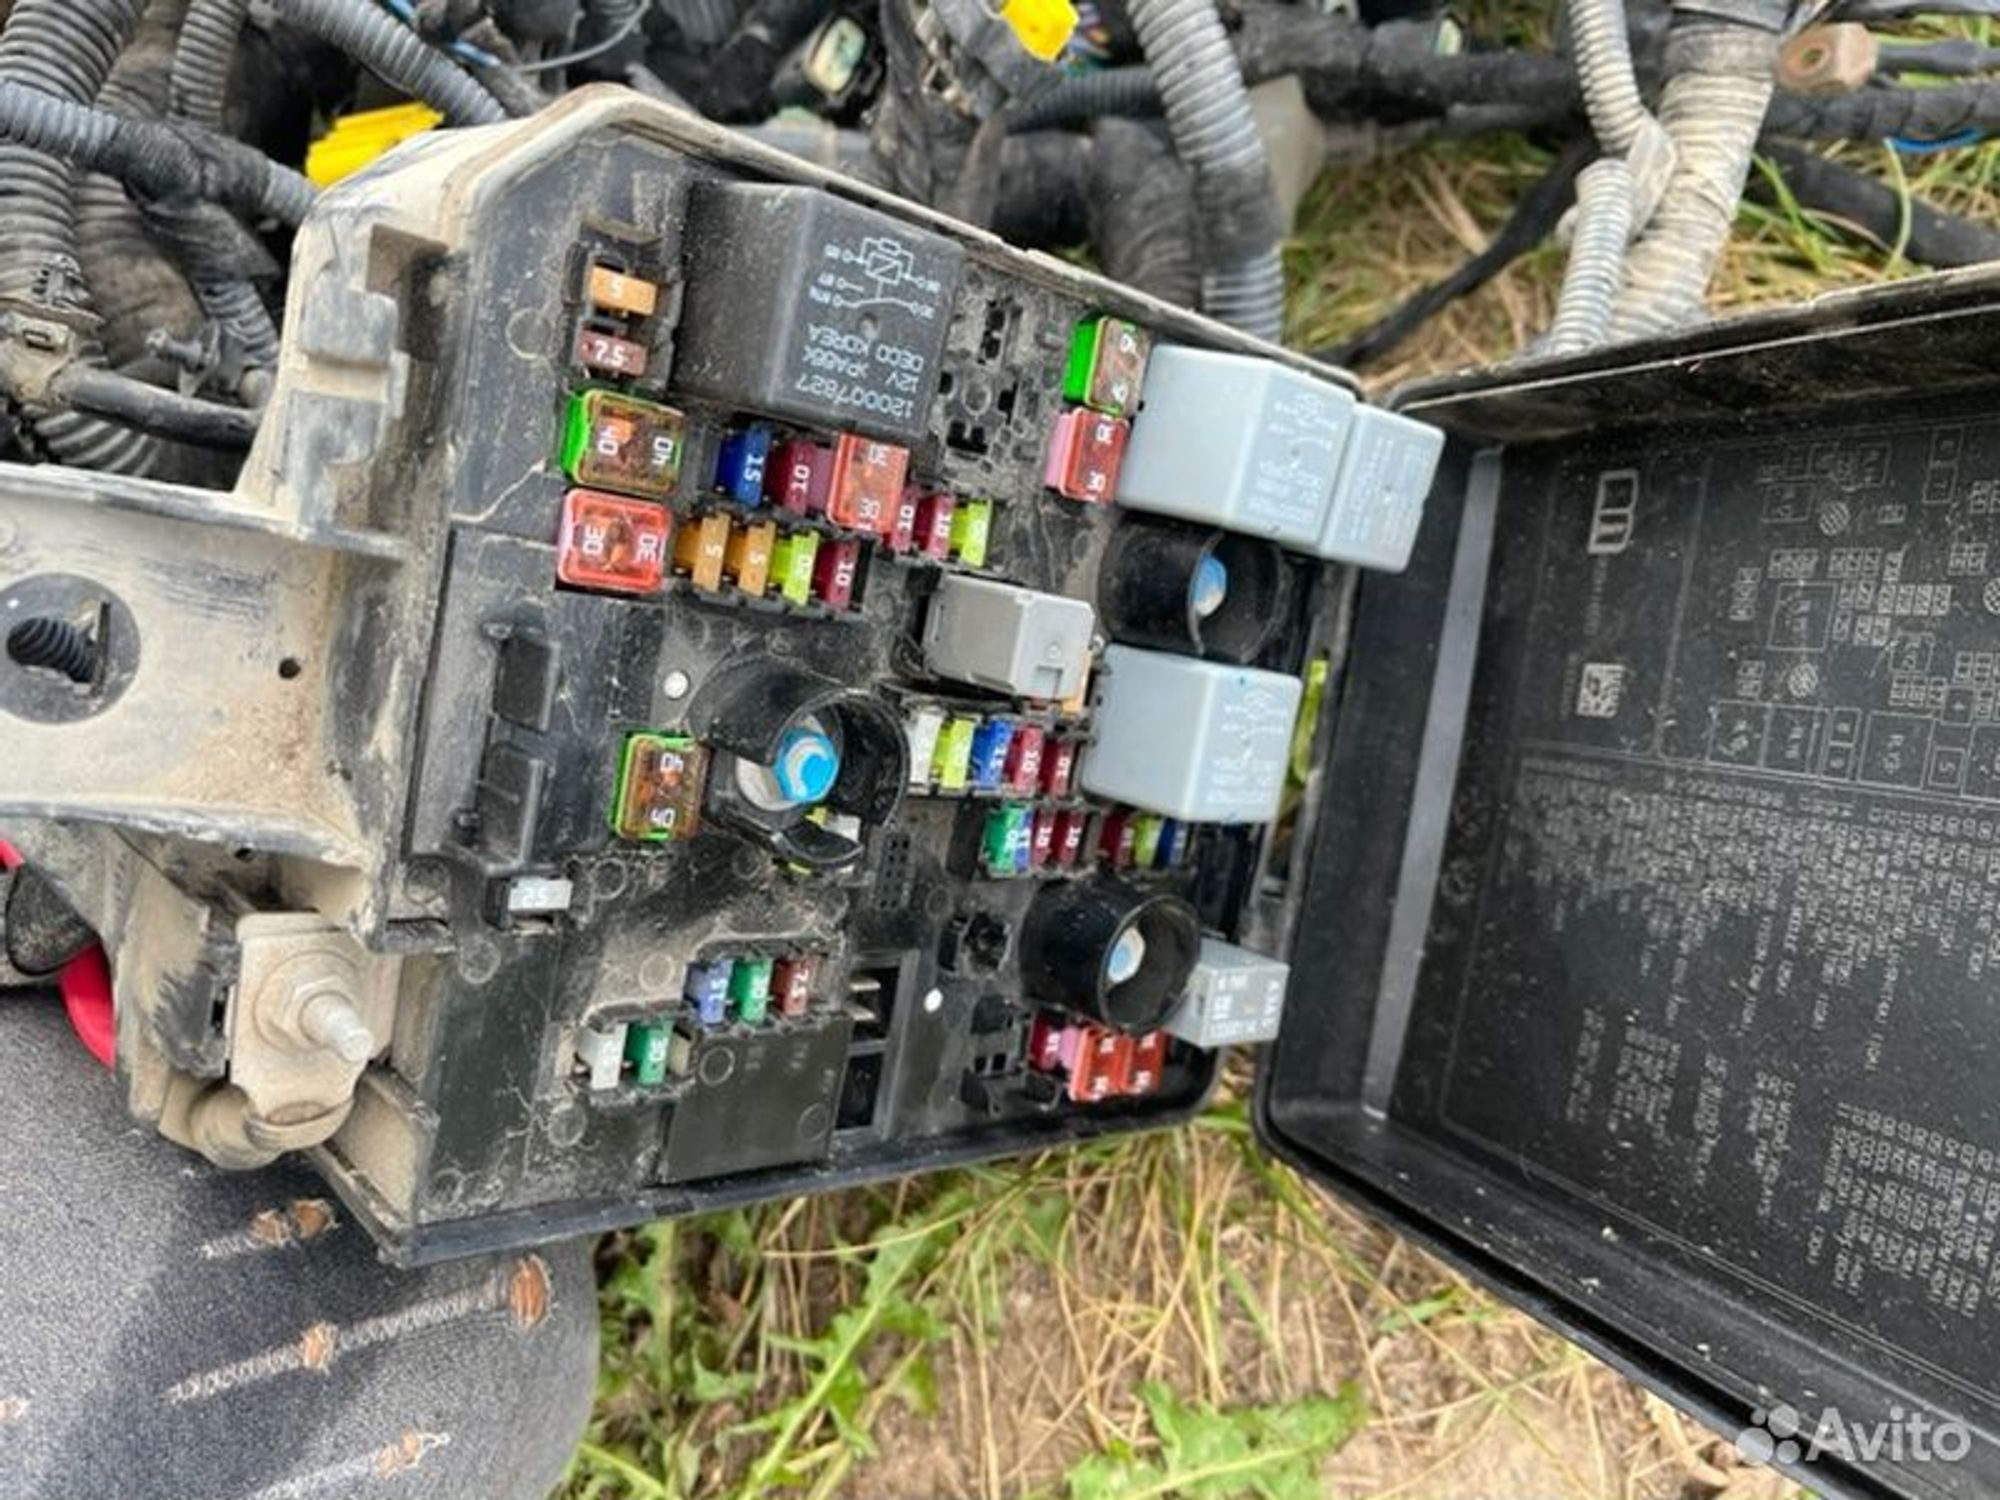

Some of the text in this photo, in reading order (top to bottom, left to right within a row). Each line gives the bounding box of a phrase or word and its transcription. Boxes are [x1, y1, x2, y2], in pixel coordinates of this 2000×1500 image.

[609, 278, 625, 298] 5
[808, 322, 870, 354] KOREA
[594, 340, 627, 364] 7.5
[653, 437, 674, 466] 40
[744, 453, 766, 483] 15
[792, 464, 810, 492] 10
[638, 532, 660, 562] 30
[705, 543, 723, 559] 5
[749, 549, 767, 565] 5
[835, 560, 854, 587] 10
